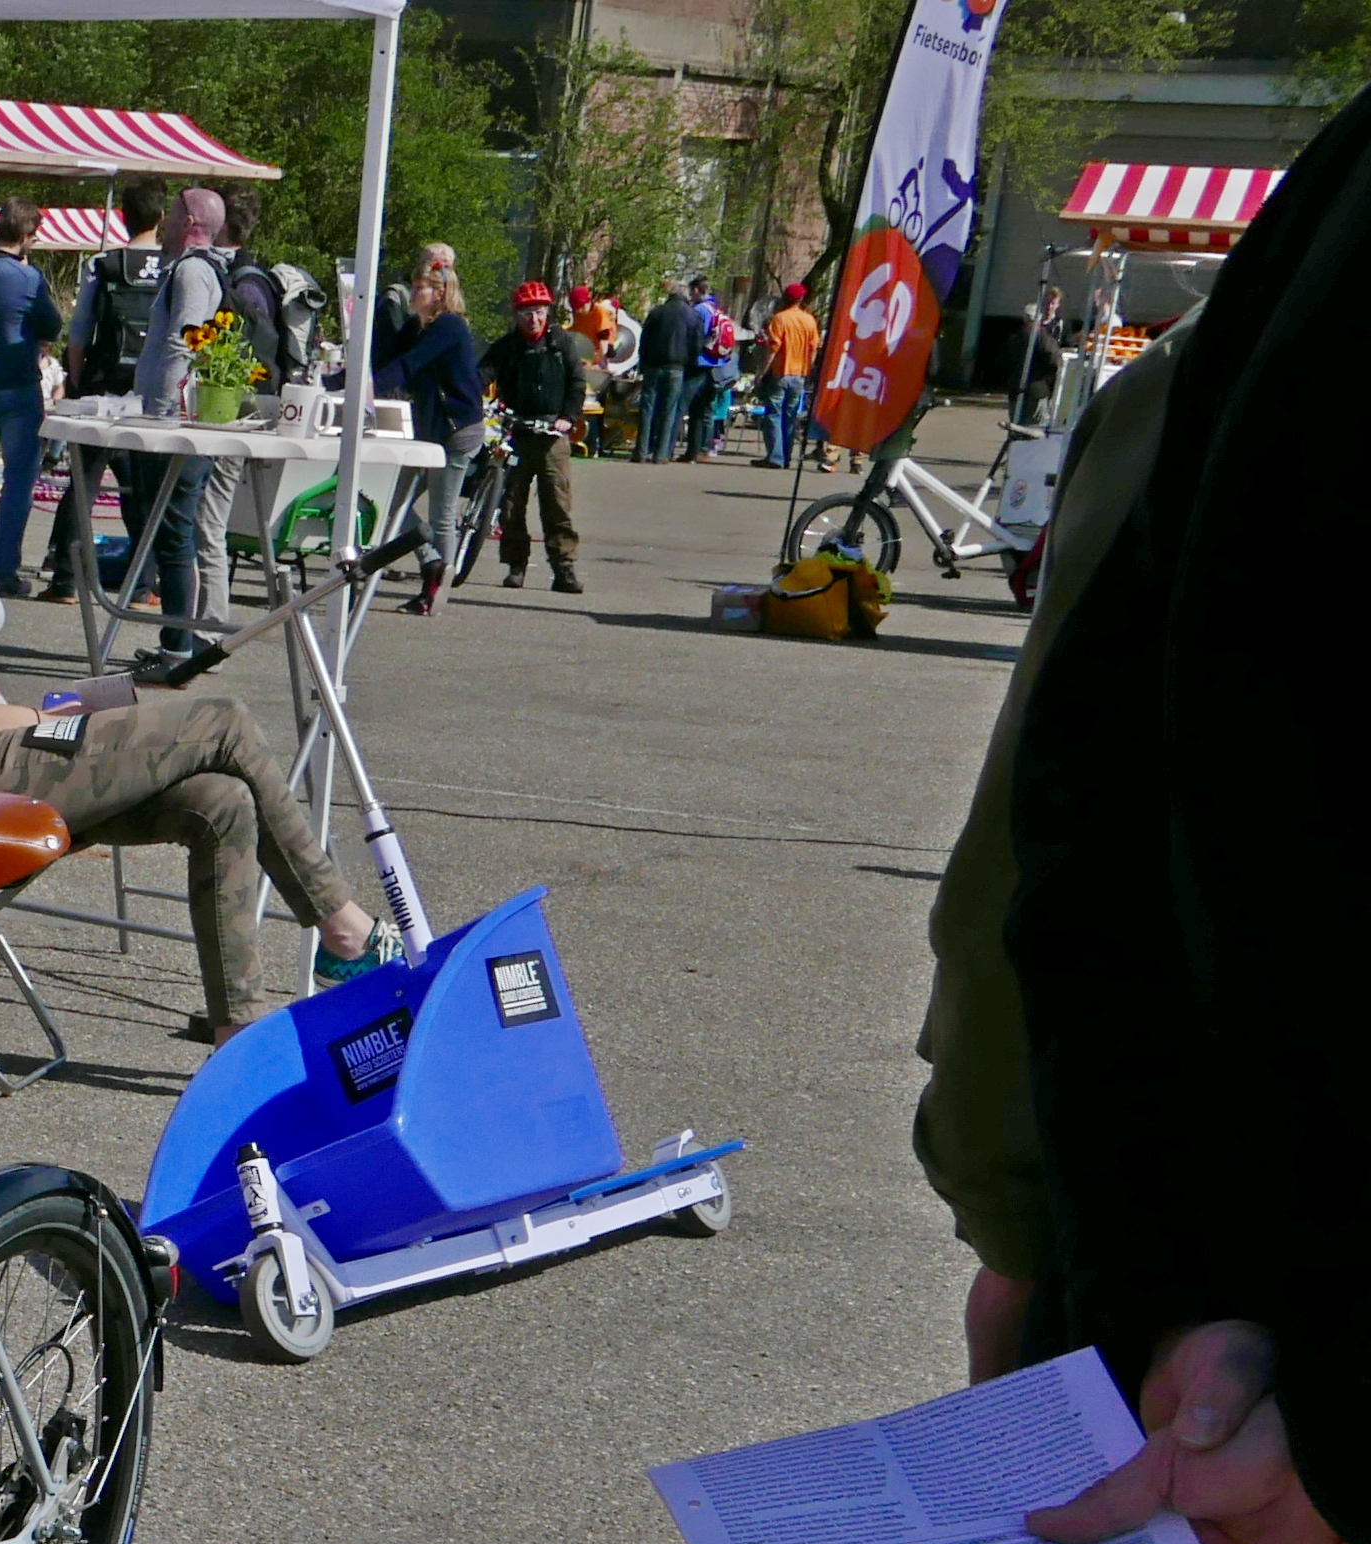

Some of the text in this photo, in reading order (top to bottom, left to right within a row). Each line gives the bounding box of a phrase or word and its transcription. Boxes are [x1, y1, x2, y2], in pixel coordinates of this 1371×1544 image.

[826, 340, 886, 405] jaa
[380, 865, 415, 932] NIMBLE
[494, 961, 541, 992] NIMBLE
[341, 1021, 404, 1068] NIMBLE
